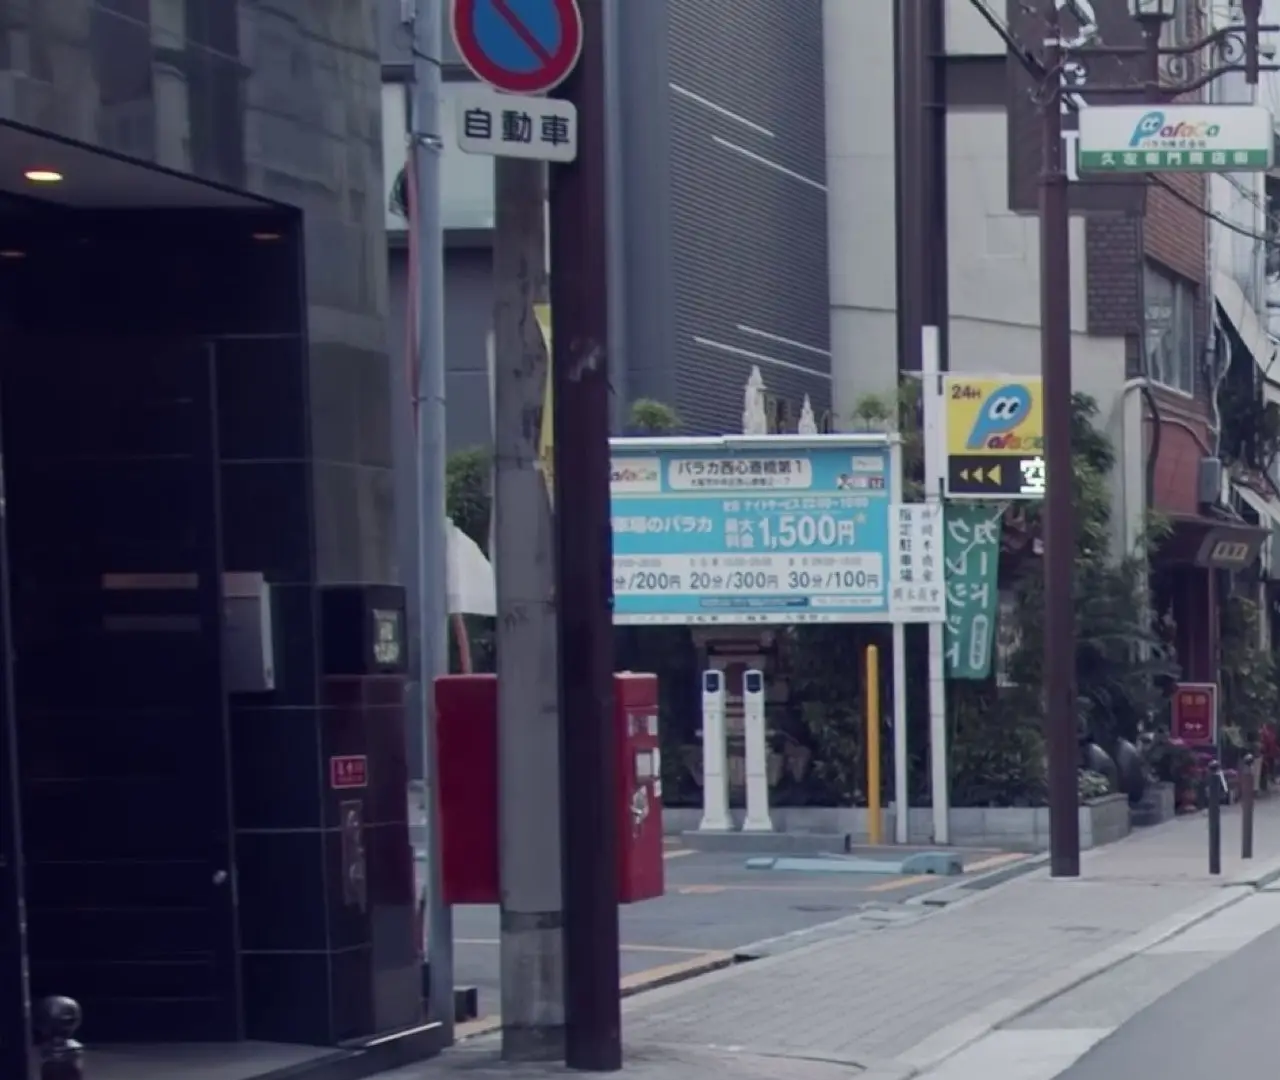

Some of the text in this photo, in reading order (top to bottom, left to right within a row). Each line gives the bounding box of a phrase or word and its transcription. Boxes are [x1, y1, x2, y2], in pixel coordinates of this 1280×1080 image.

[464, 107, 570, 146] 自動車
[758, 515, 855, 549] 1,500円
[690, 571, 779, 590] 20分/300円
[787, 570, 879, 589] 30分/100円
